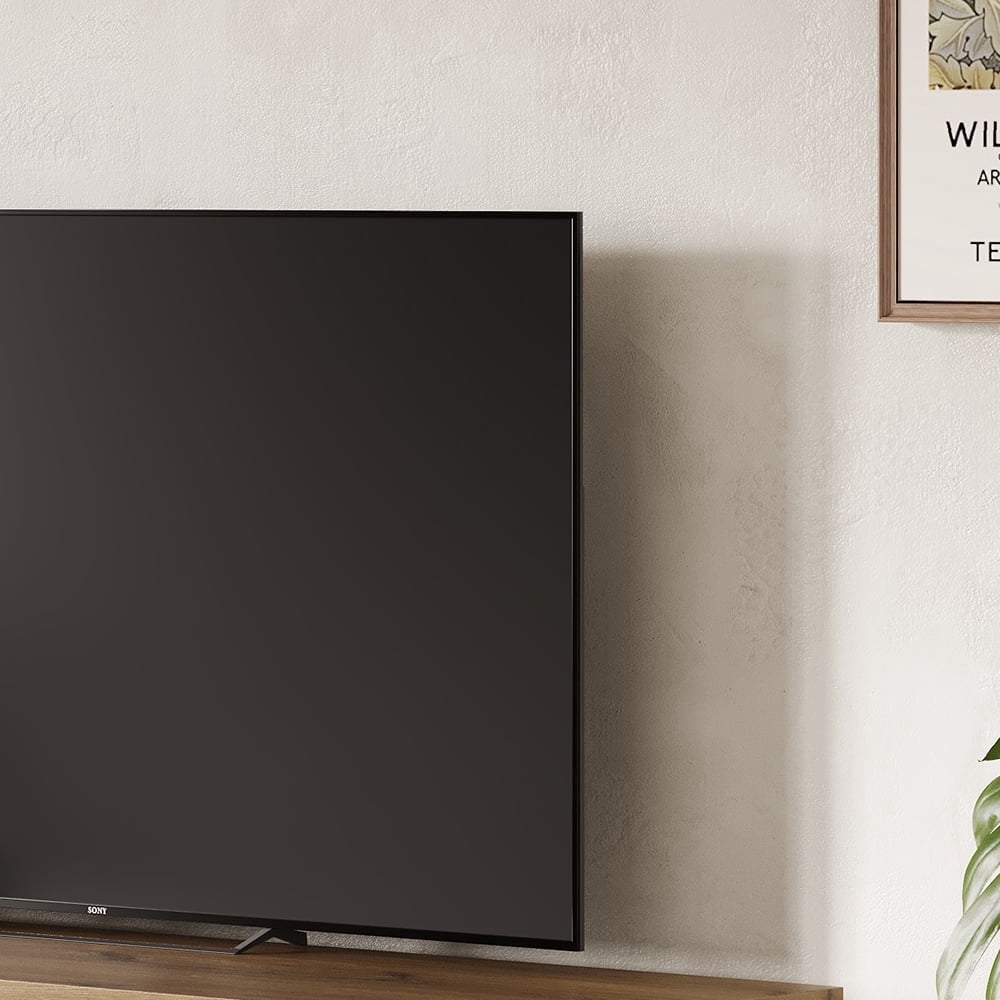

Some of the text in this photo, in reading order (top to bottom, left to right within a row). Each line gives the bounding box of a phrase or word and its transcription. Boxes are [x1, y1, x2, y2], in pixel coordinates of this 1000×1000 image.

[946, 121, 1000, 147] WIL
[977, 169, 1000, 185] AR
[970, 241, 1000, 262] TE
[87, 906, 107, 915] SONY
